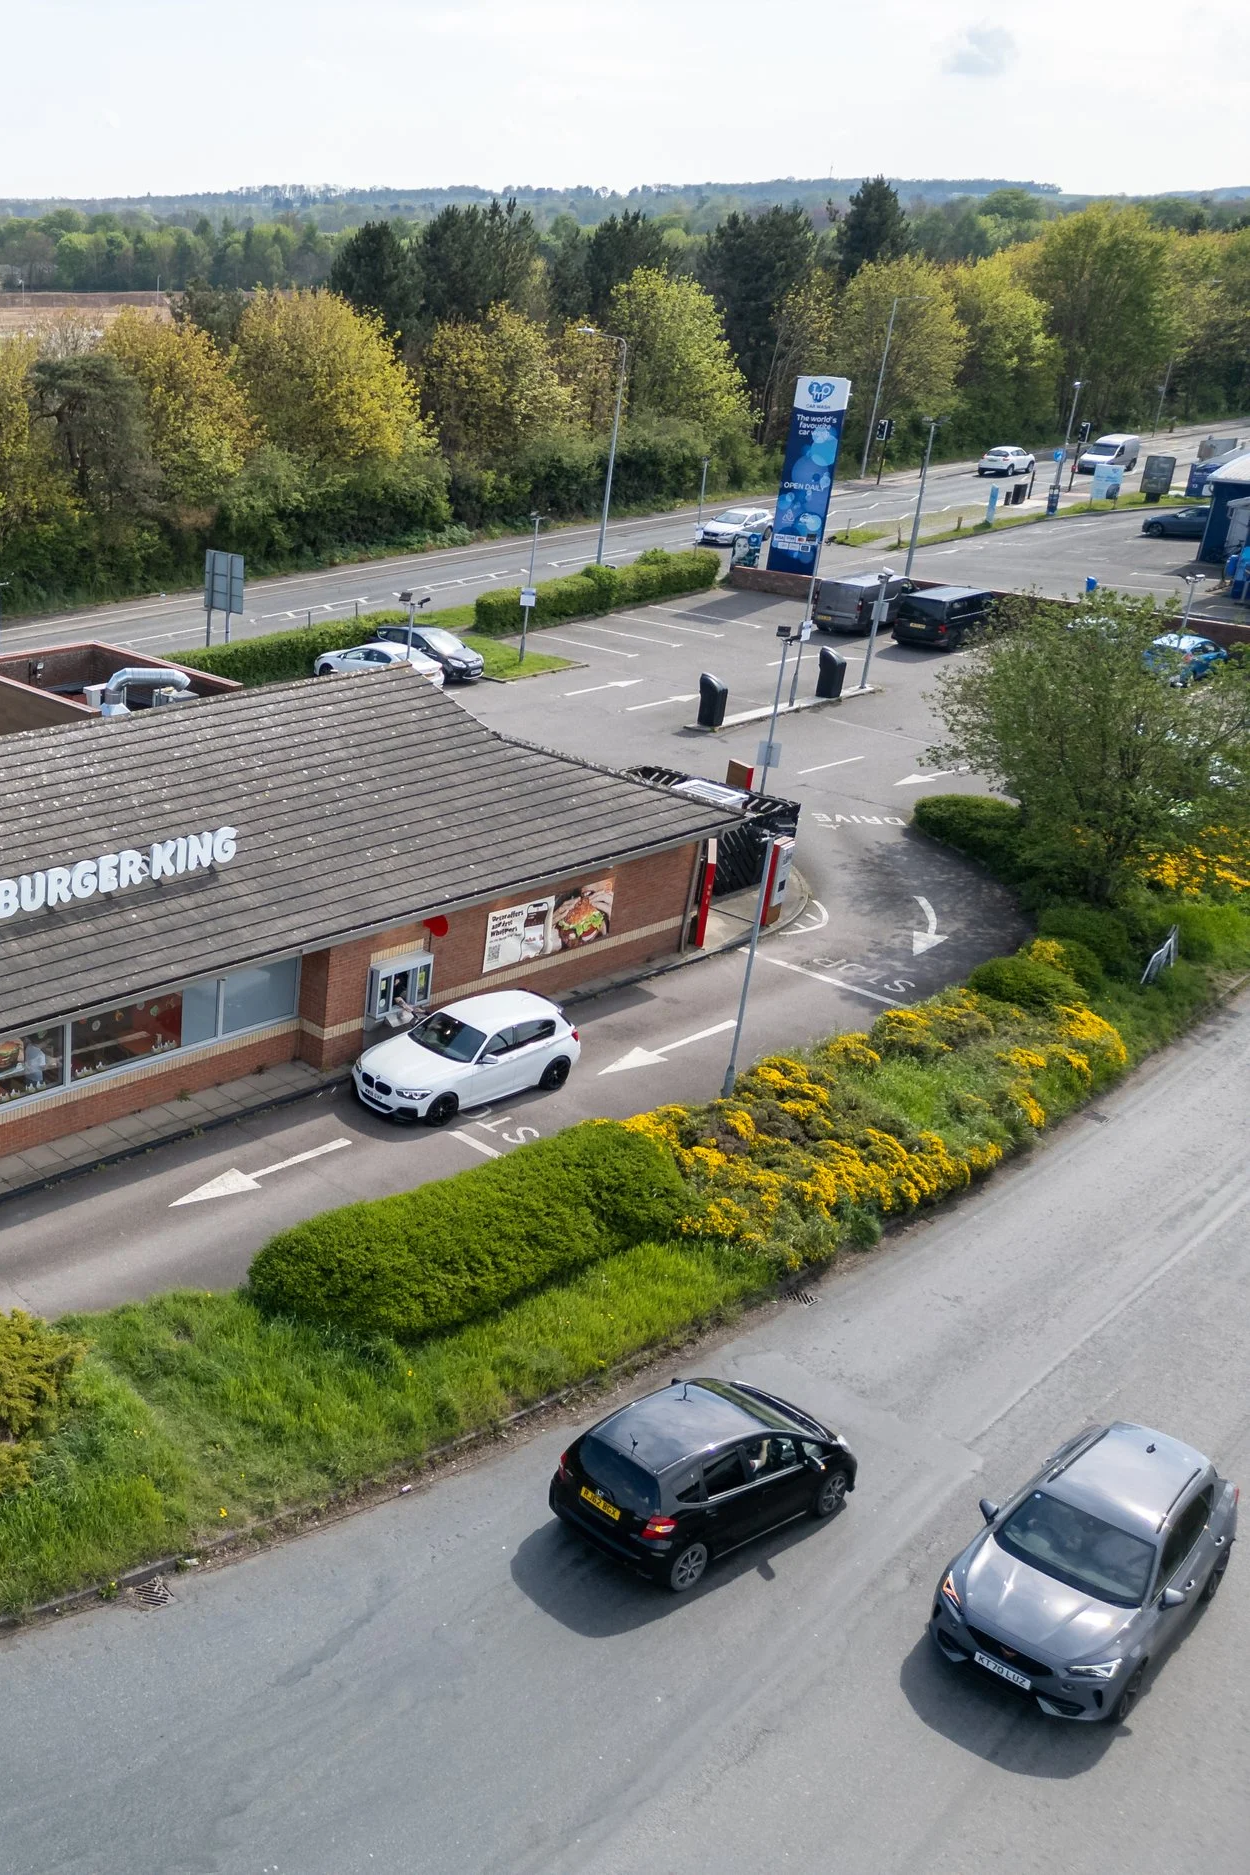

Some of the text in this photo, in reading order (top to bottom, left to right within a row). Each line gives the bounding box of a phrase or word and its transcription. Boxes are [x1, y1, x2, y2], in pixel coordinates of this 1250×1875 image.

[799, 421, 831, 430] favourite
[811, 415, 837, 423] world's
[784, 481, 825, 492] OPEN DAILY
[811, 812, 908, 826] DRIVE
[150, 826, 240, 881] KING
[583, 1489, 617, 1518] RJ62 BGX
[978, 1654, 1026, 1686] KT70 LUZ
